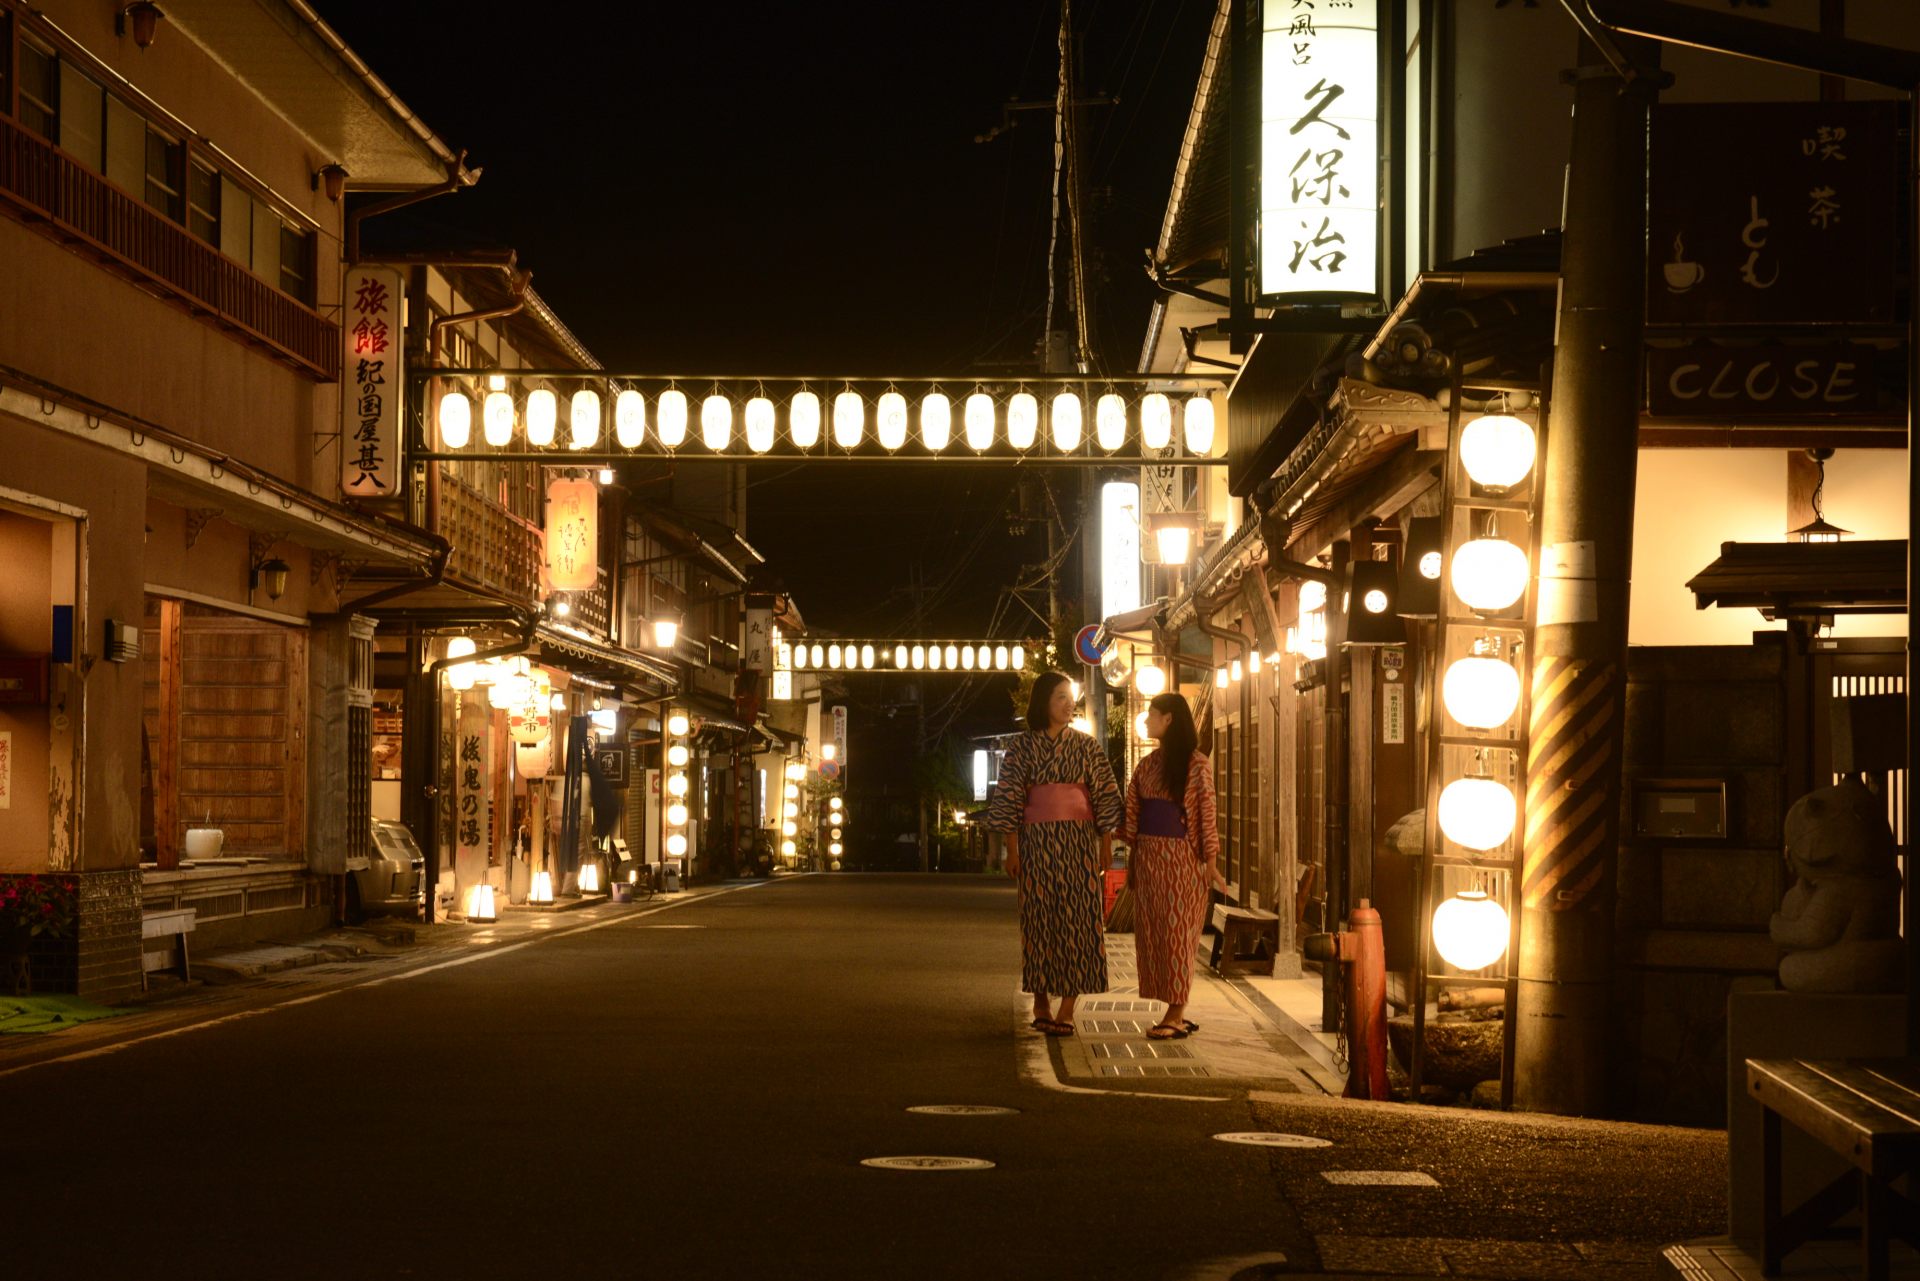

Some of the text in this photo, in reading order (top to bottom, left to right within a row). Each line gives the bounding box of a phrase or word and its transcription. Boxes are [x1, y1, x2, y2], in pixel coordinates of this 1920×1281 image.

[1288, 77, 1352, 277] 久保治
[1801, 125, 1848, 231] 喫茶
[1738, 193, 1781, 290] とも
[349, 277, 389, 488] 旅館 紀の国屋甚八
[1668, 359, 1860, 403] CLOSE
[750, 622, 763, 663] 丸屋
